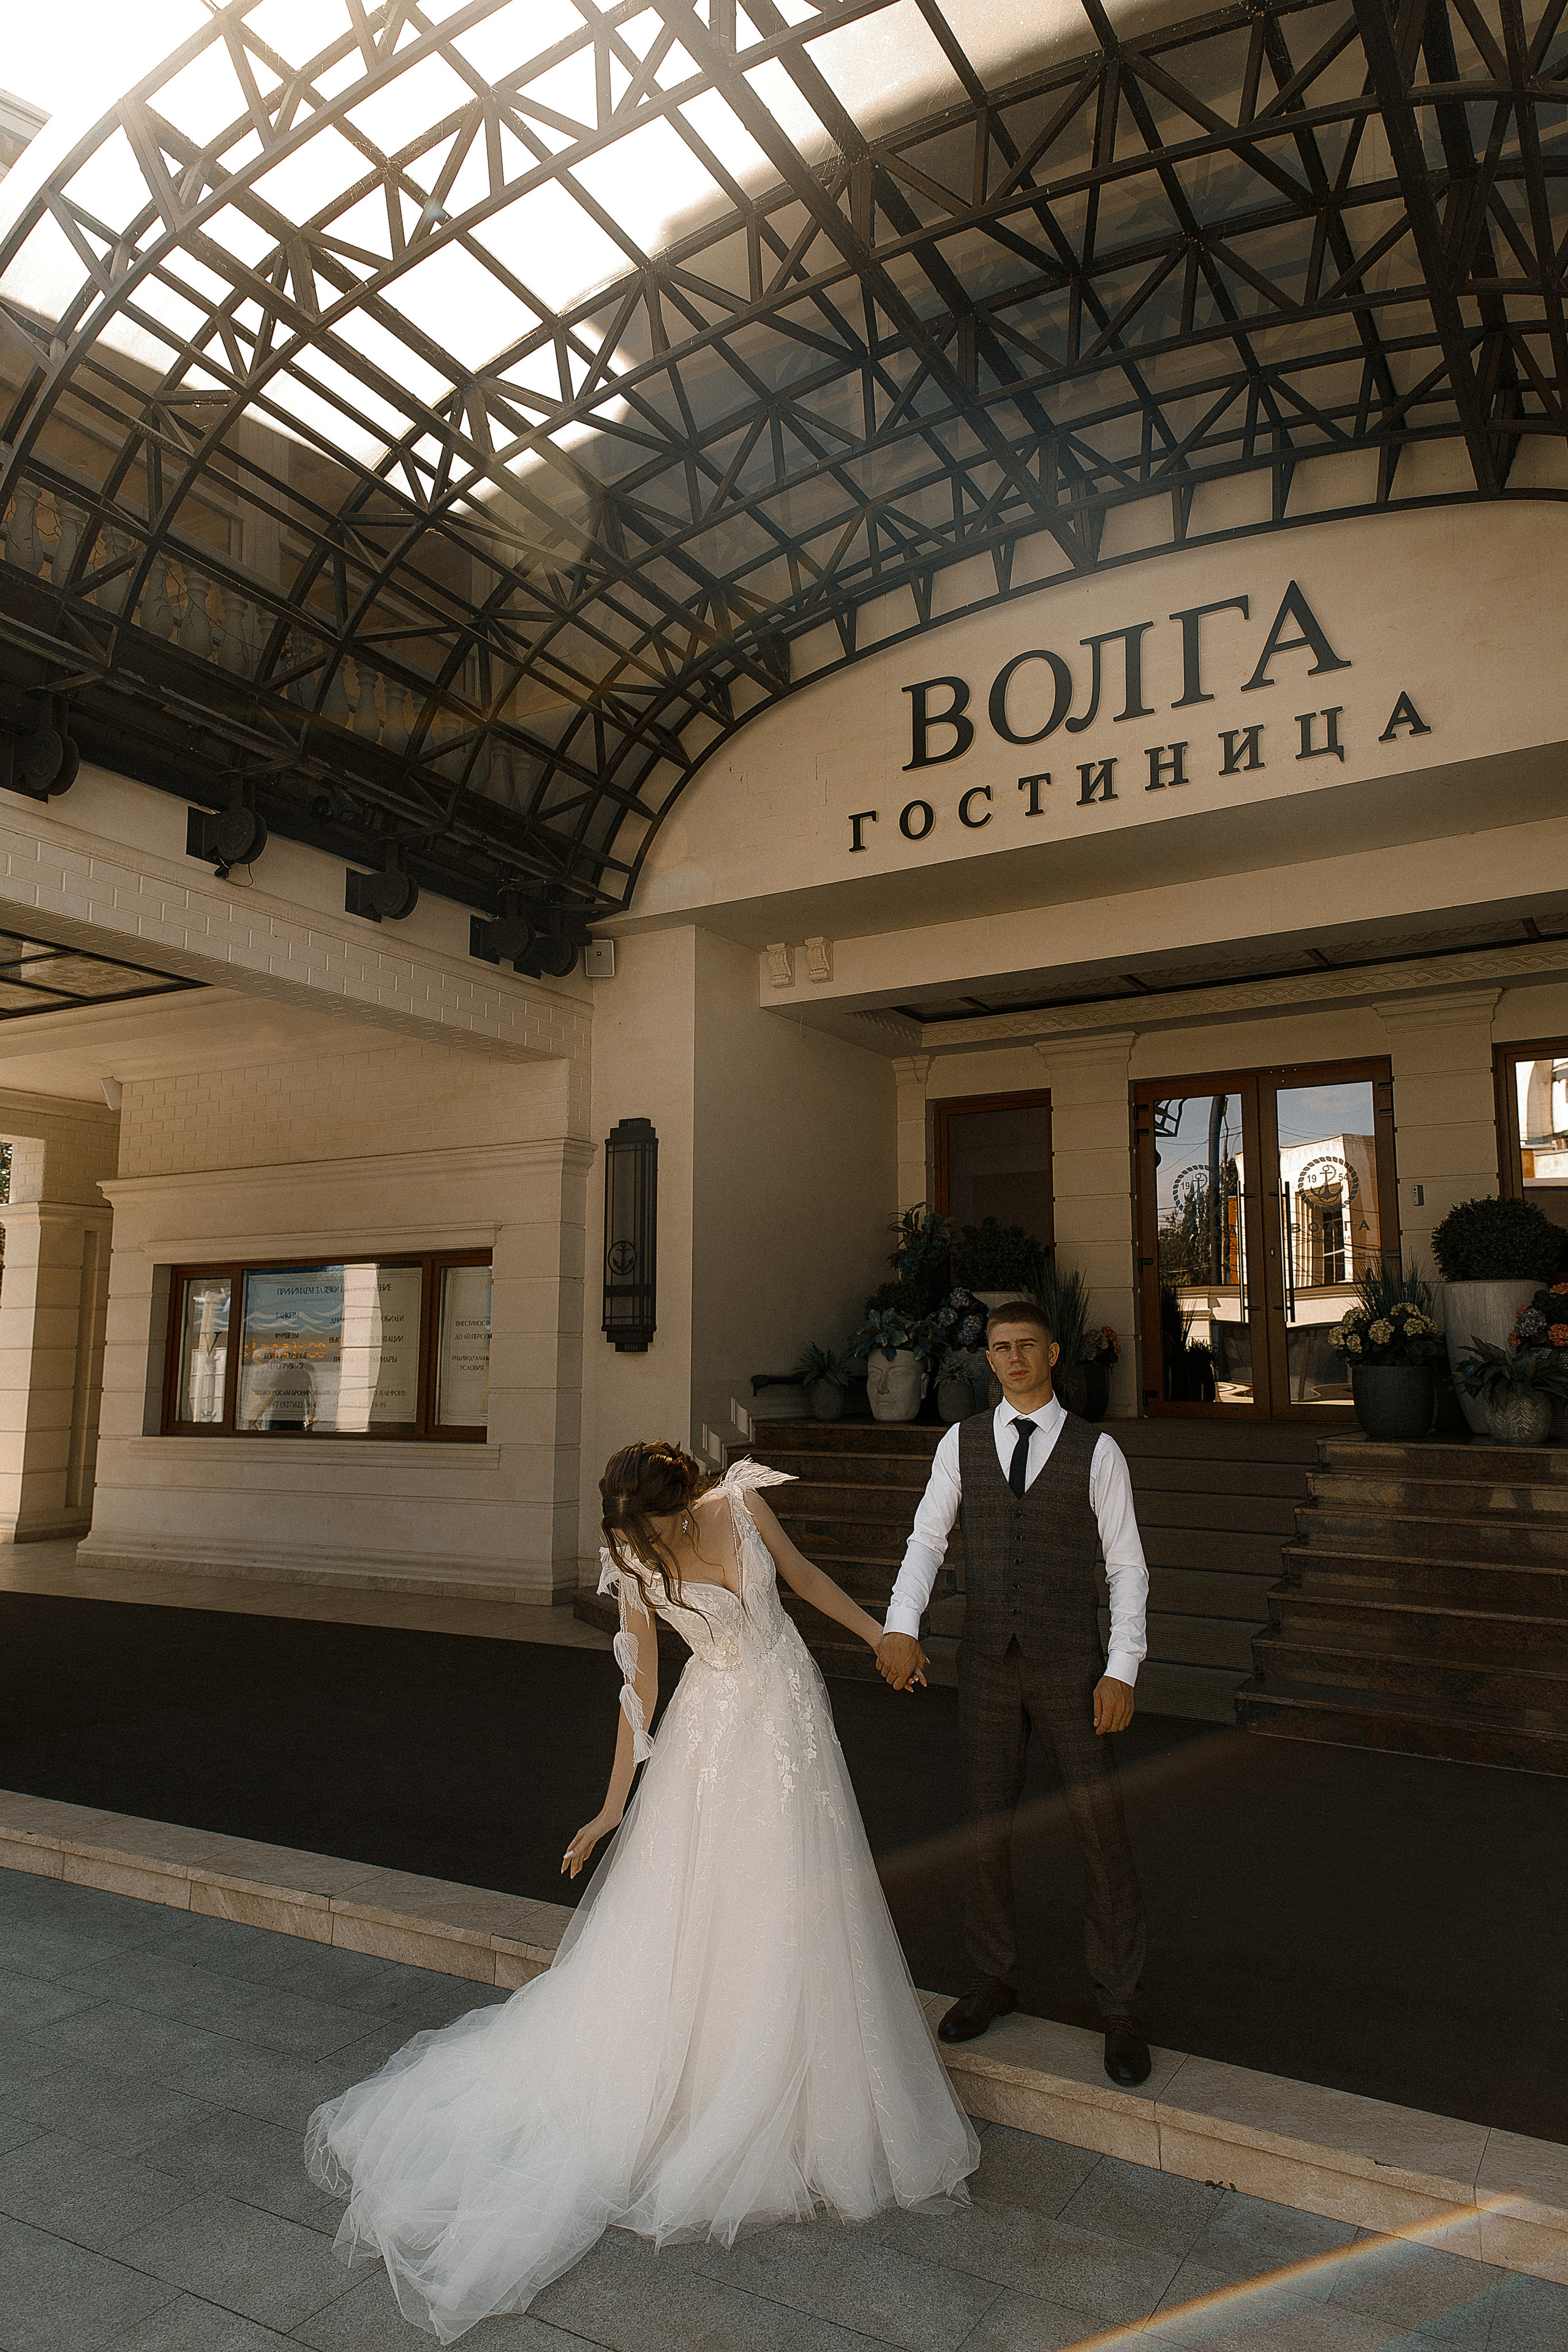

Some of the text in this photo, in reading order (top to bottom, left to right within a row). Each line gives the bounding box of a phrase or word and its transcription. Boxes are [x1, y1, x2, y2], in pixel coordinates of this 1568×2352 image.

[900, 579, 1352, 772] ВОЛГА
[848, 690, 1431, 853] ГОСТИНИЦА
[1306, 1173, 1349, 1183] 19 54
[1181, 1182, 1190, 1190] 19
[277, 1287, 314, 1295] ПРИНИМАЕМ
[315, 1286, 340, 1294] ЗАЯВКИ
